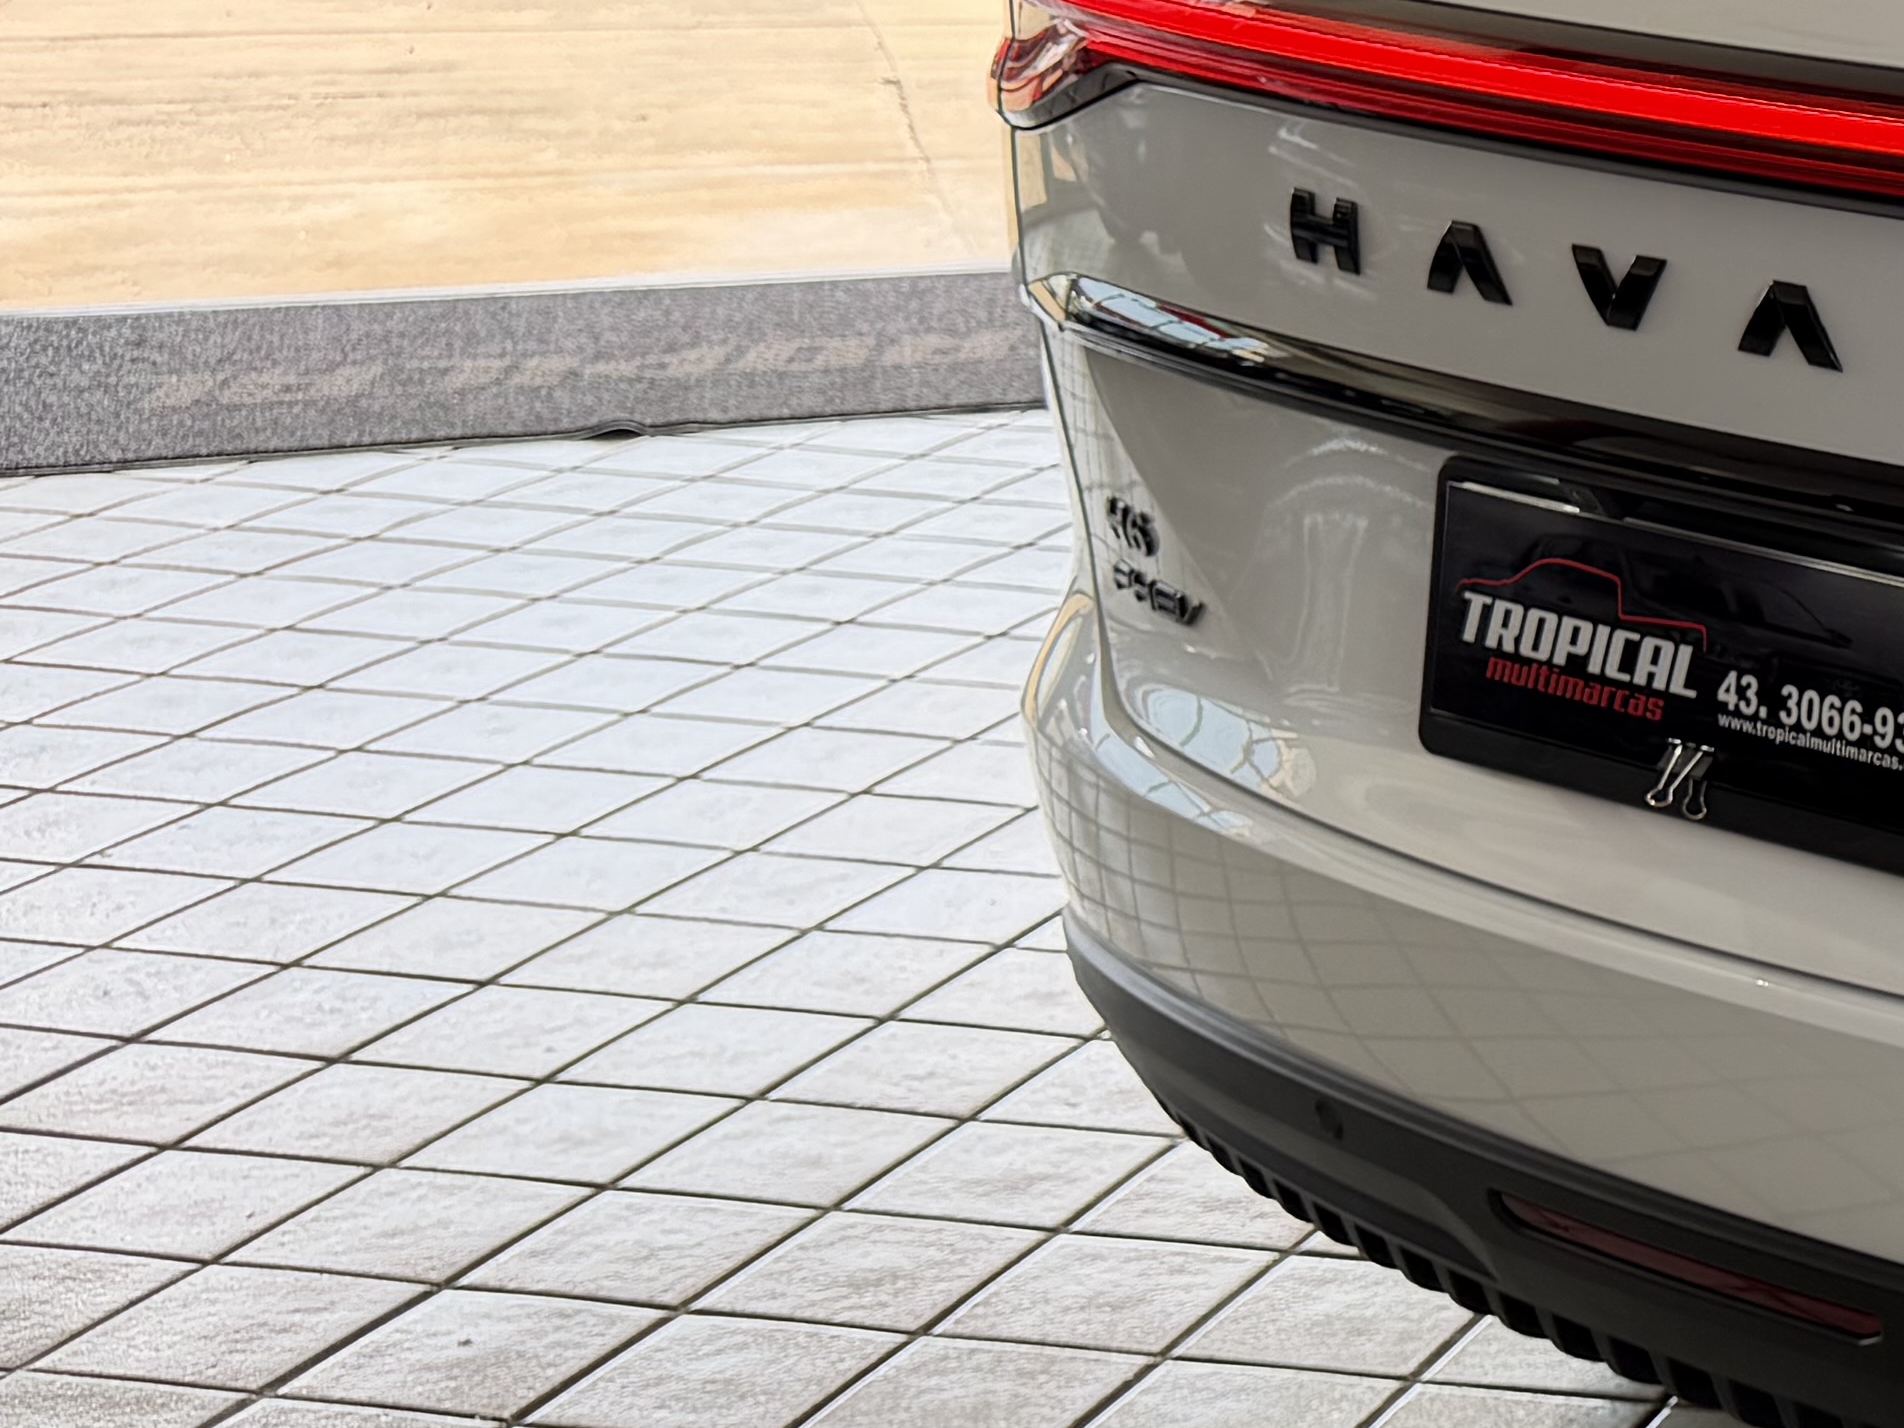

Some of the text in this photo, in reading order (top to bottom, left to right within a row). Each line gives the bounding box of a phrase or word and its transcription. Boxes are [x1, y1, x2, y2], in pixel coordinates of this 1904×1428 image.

[1461, 590, 1698, 699] TROPICAL
[1485, 656, 1665, 721] multimarcas
[1716, 670, 1768, 720] 43.
